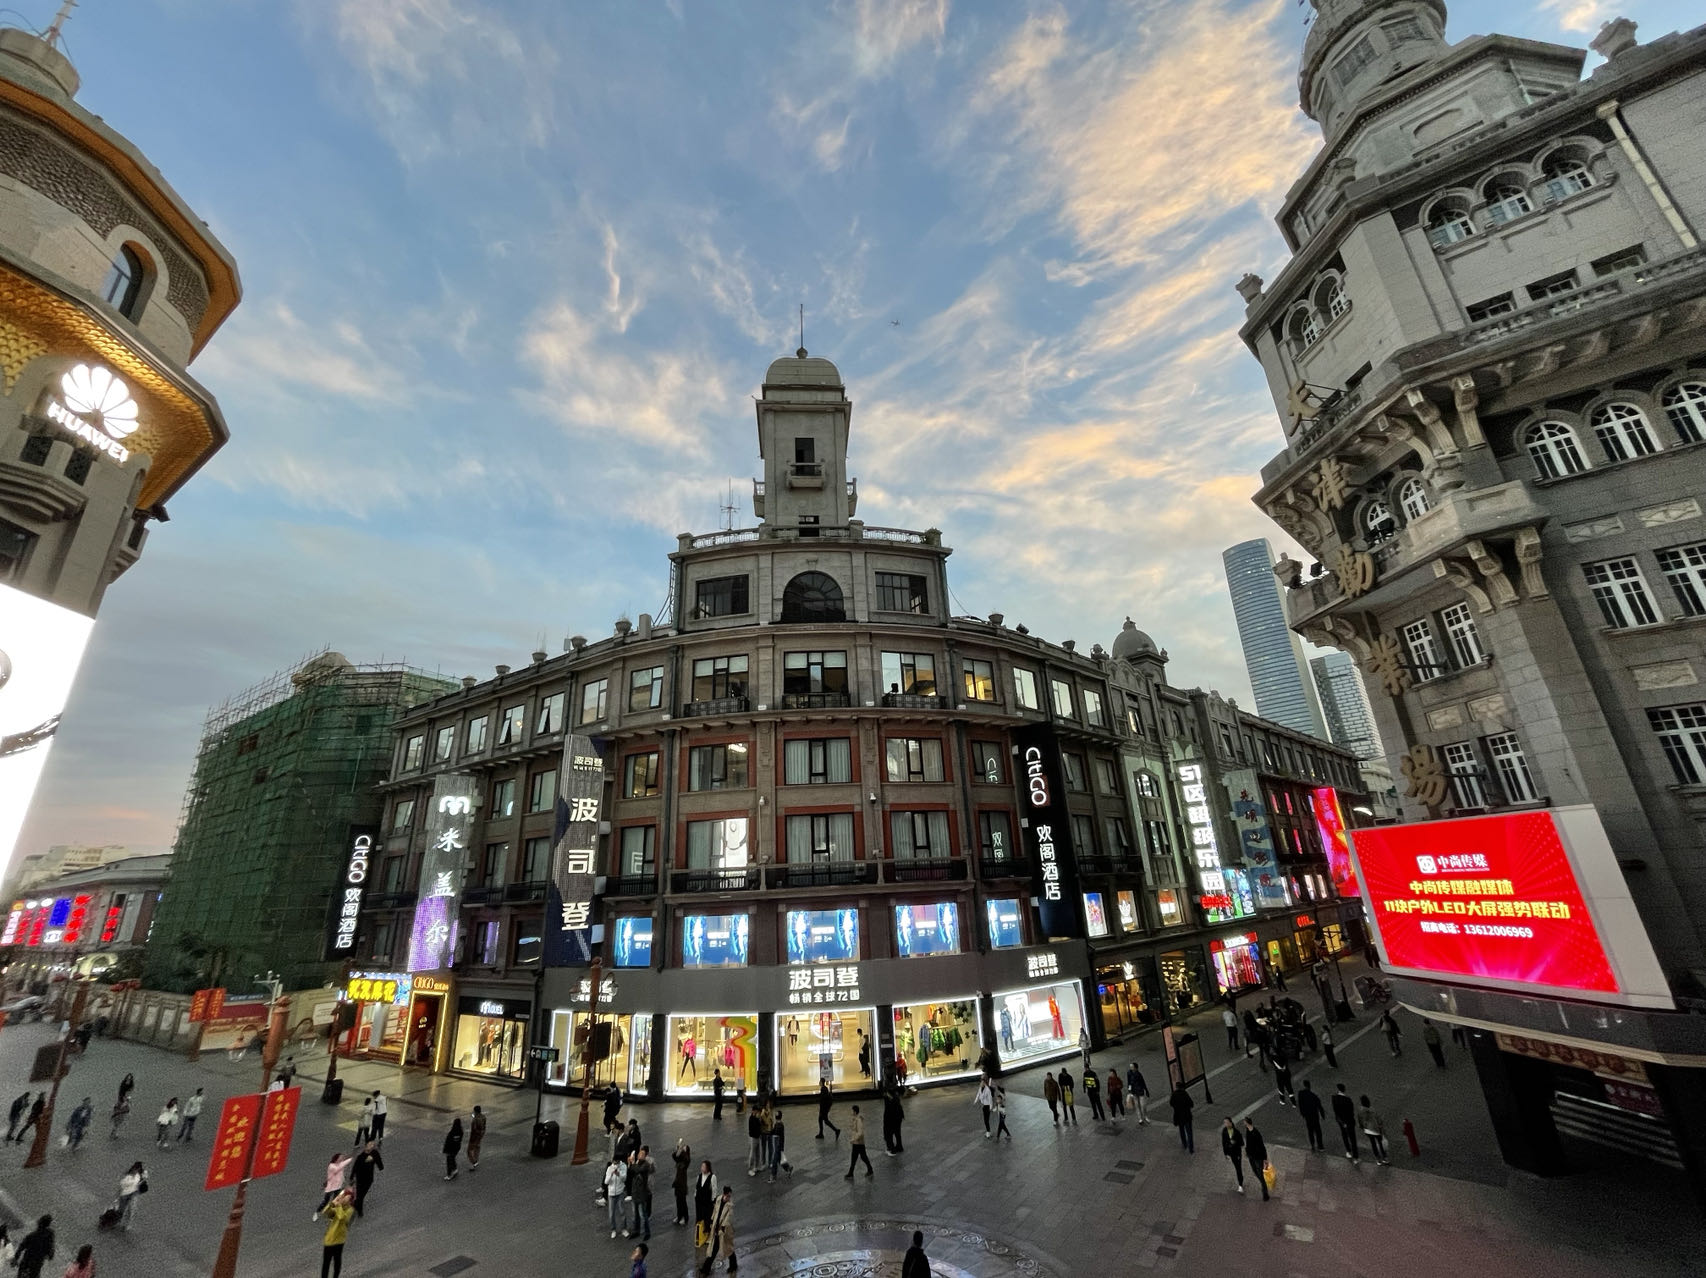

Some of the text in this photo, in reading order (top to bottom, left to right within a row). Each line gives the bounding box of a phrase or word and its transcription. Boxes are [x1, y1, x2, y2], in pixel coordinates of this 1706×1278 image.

[47, 401, 130, 463] HUAWEI
[561, 798, 599, 931] 波司登
[1036, 825, 1061, 900] 欢阁酒店
[1437, 854, 1488, 869] 中尚传媒
[426, 828, 463, 944] 米盖尔
[1409, 879, 1514, 896] 中尚传媒融媒体
[336, 888, 362, 948] 欢阁酒店
[1385, 900, 1571, 919] 11块户外LED大屏强势联动
[789, 966, 858, 990] 波司登
[789, 989, 860, 1004] 畅销全球72国
